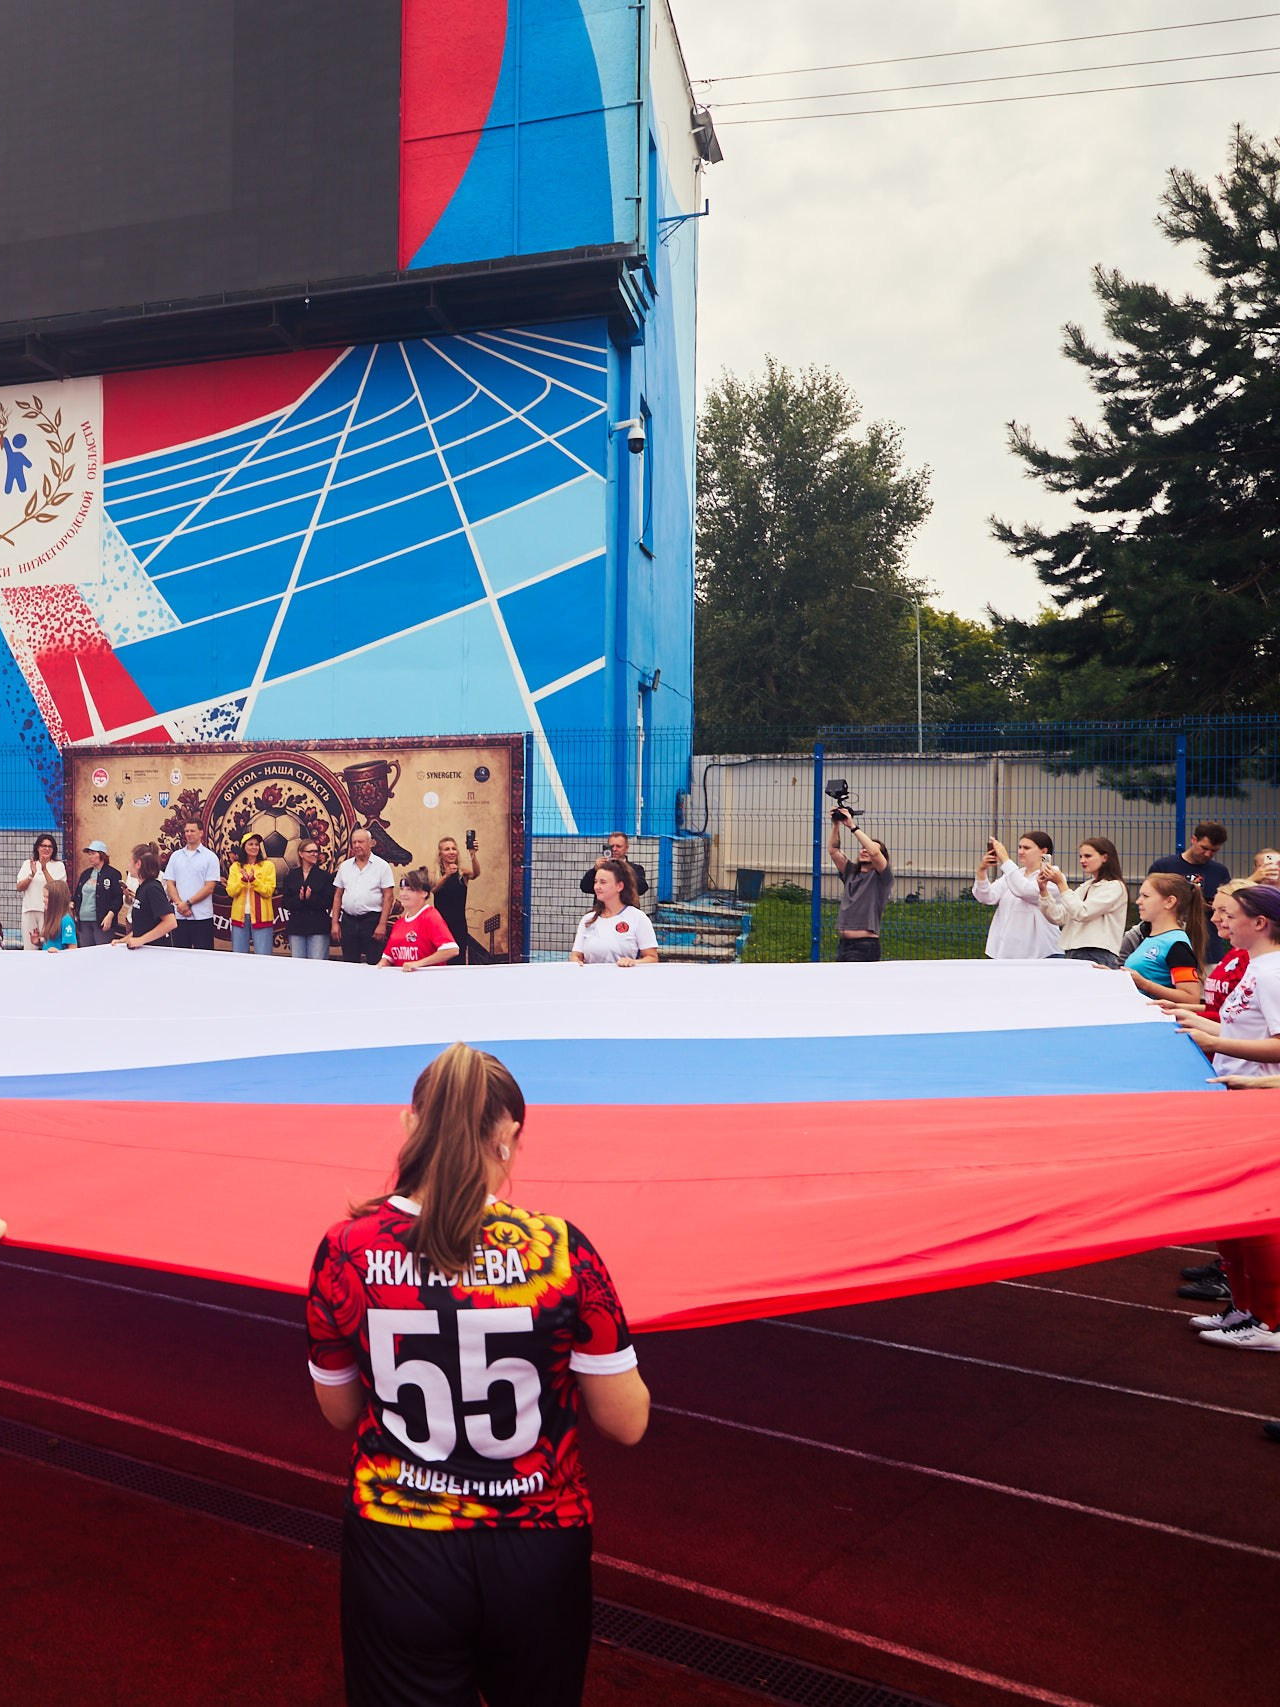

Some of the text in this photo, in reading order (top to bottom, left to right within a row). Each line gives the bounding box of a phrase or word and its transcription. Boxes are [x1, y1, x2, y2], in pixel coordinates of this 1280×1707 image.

[18, 490, 94, 574] НИЖЕГОРОДСКОЙ
[80, 420, 98, 480] ОБЛАСТИ
[224, 771, 257, 802] ФУТБОЛ
[264, 766, 294, 776] НАША
[295, 770, 330, 802] СТРАСТЬ
[426, 771, 462, 779] SYNERGETIC
[367, 1306, 542, 1462] 55
